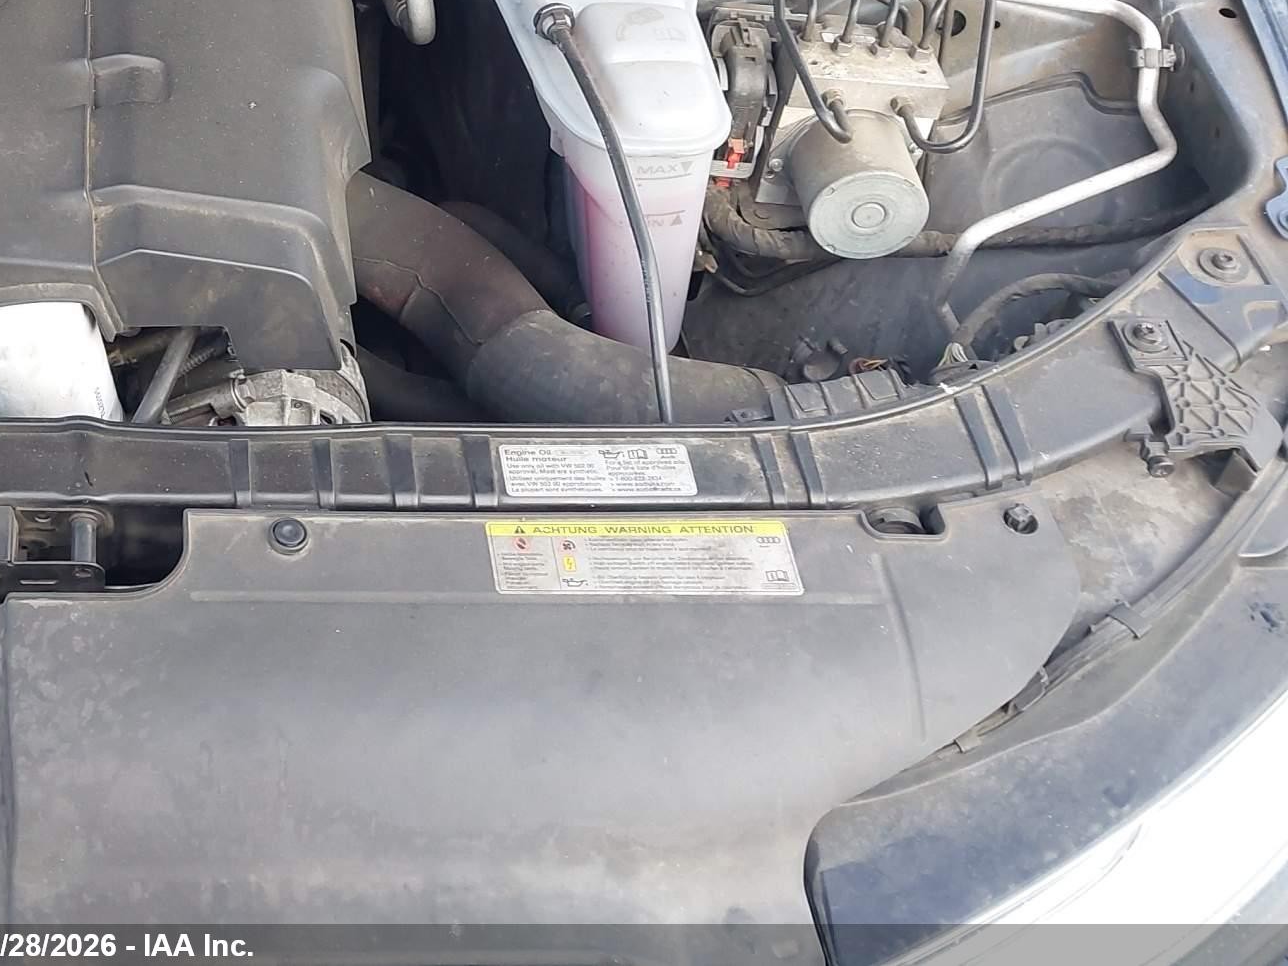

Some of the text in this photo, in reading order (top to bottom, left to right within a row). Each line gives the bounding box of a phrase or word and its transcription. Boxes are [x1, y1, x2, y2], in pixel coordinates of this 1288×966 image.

[637, 164, 678, 175] MAX
[532, 525, 754, 534] ACHTUNG WARNING ATTENTION
